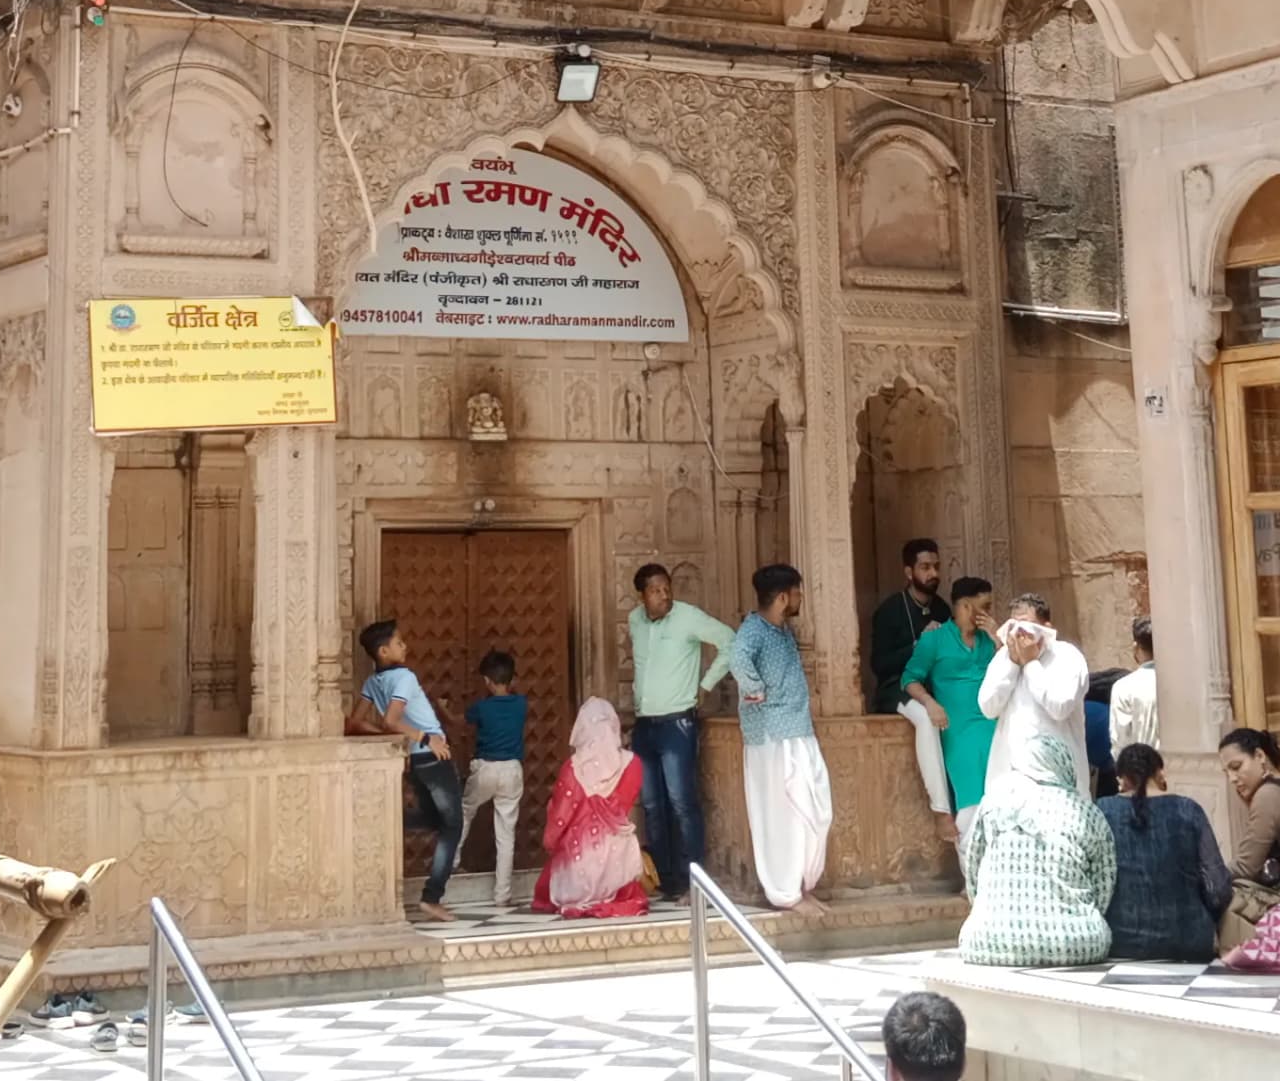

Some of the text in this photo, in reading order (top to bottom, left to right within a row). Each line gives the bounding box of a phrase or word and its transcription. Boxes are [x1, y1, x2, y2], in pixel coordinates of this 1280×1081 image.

[461, 180, 552, 212] रमण
[560, 197, 641, 268] मंदिर
[444, 224, 474, 240] वैशाख
[477, 229, 501, 246] शुक्ल
[503, 226, 532, 246] पूर्णिमा
[554, 251, 577, 267] पीठ
[384, 270, 419, 283] मंदिर
[423, 271, 487, 288] (पंजीकृत)
[492, 273, 509, 286] श्री
[571, 275, 589, 287] जी
[592, 279, 640, 289] महाराज
[438, 294, 489, 308] वृन्दावन
[506, 296, 542, 307] 281121
[167, 305, 258, 331] वर्जित क्षेत्र
[435, 310, 485, 326] वेबसाइट
[496, 313, 675, 328] www.radharamanmandir.com
